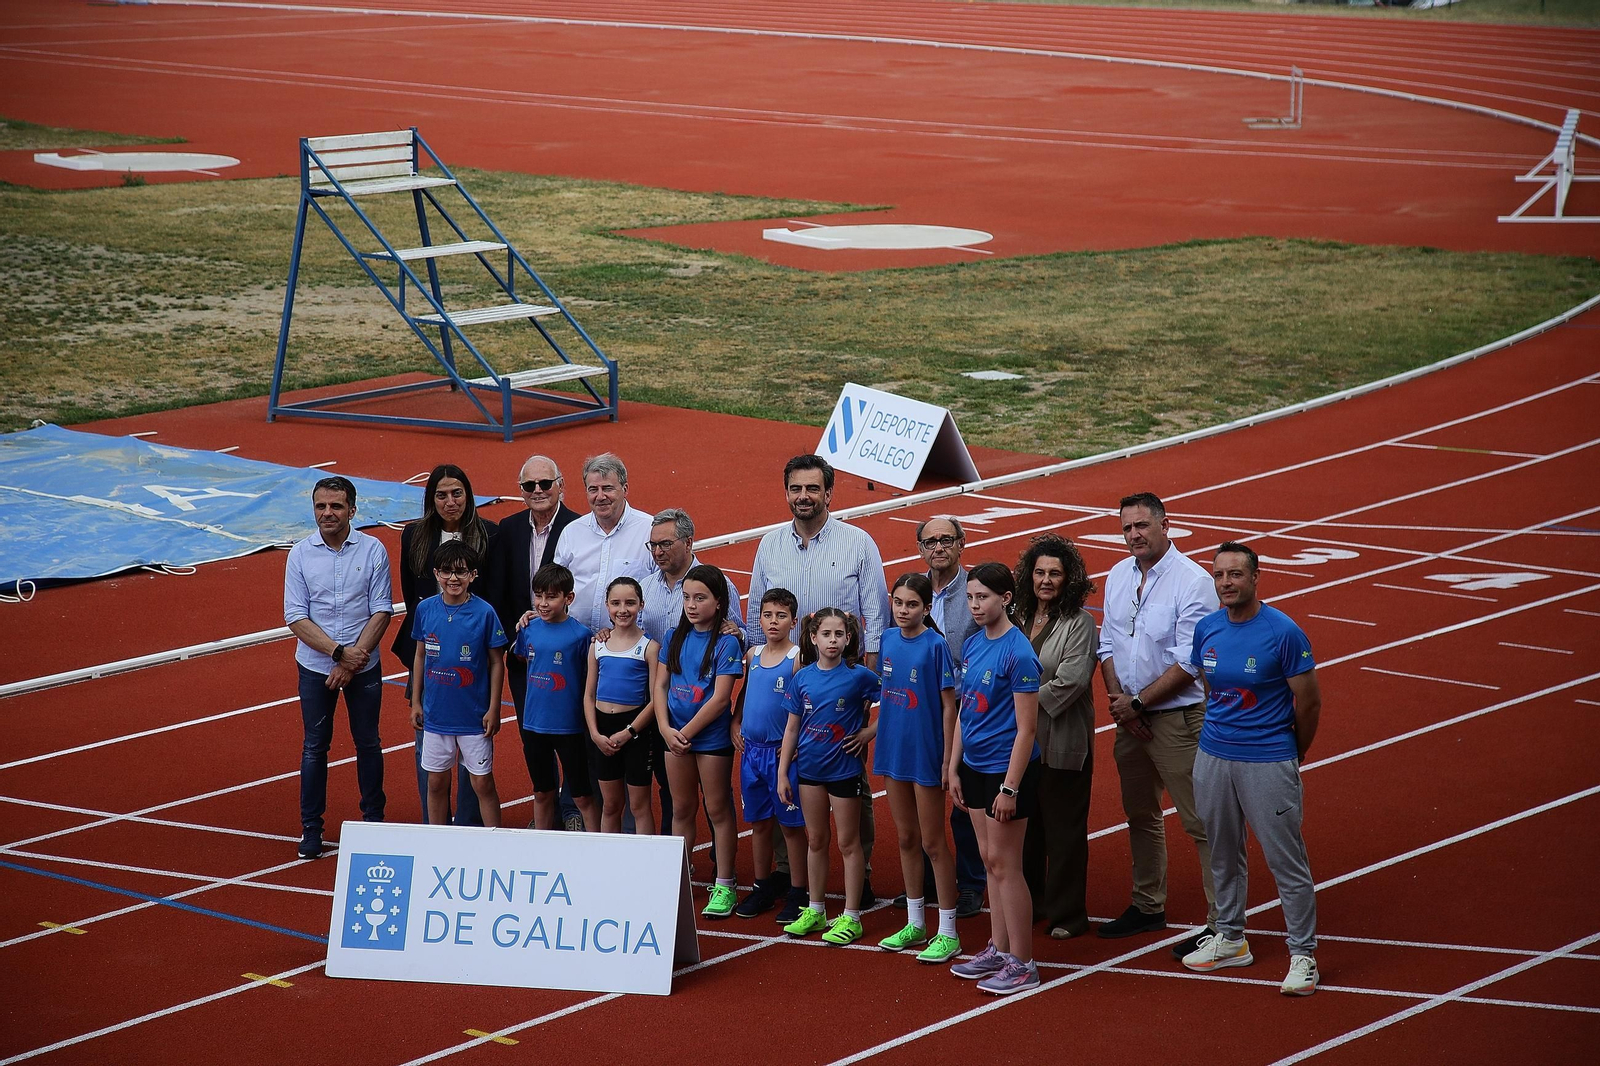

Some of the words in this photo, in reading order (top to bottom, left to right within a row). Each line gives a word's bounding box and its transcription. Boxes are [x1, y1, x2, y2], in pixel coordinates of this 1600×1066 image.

[870, 411, 934, 443] DEPORTE
[859, 439, 915, 470] GALEGO
[428, 866, 572, 906] XUNTA
[423, 910, 477, 946] DE
[491, 913, 661, 956] GALICIA
